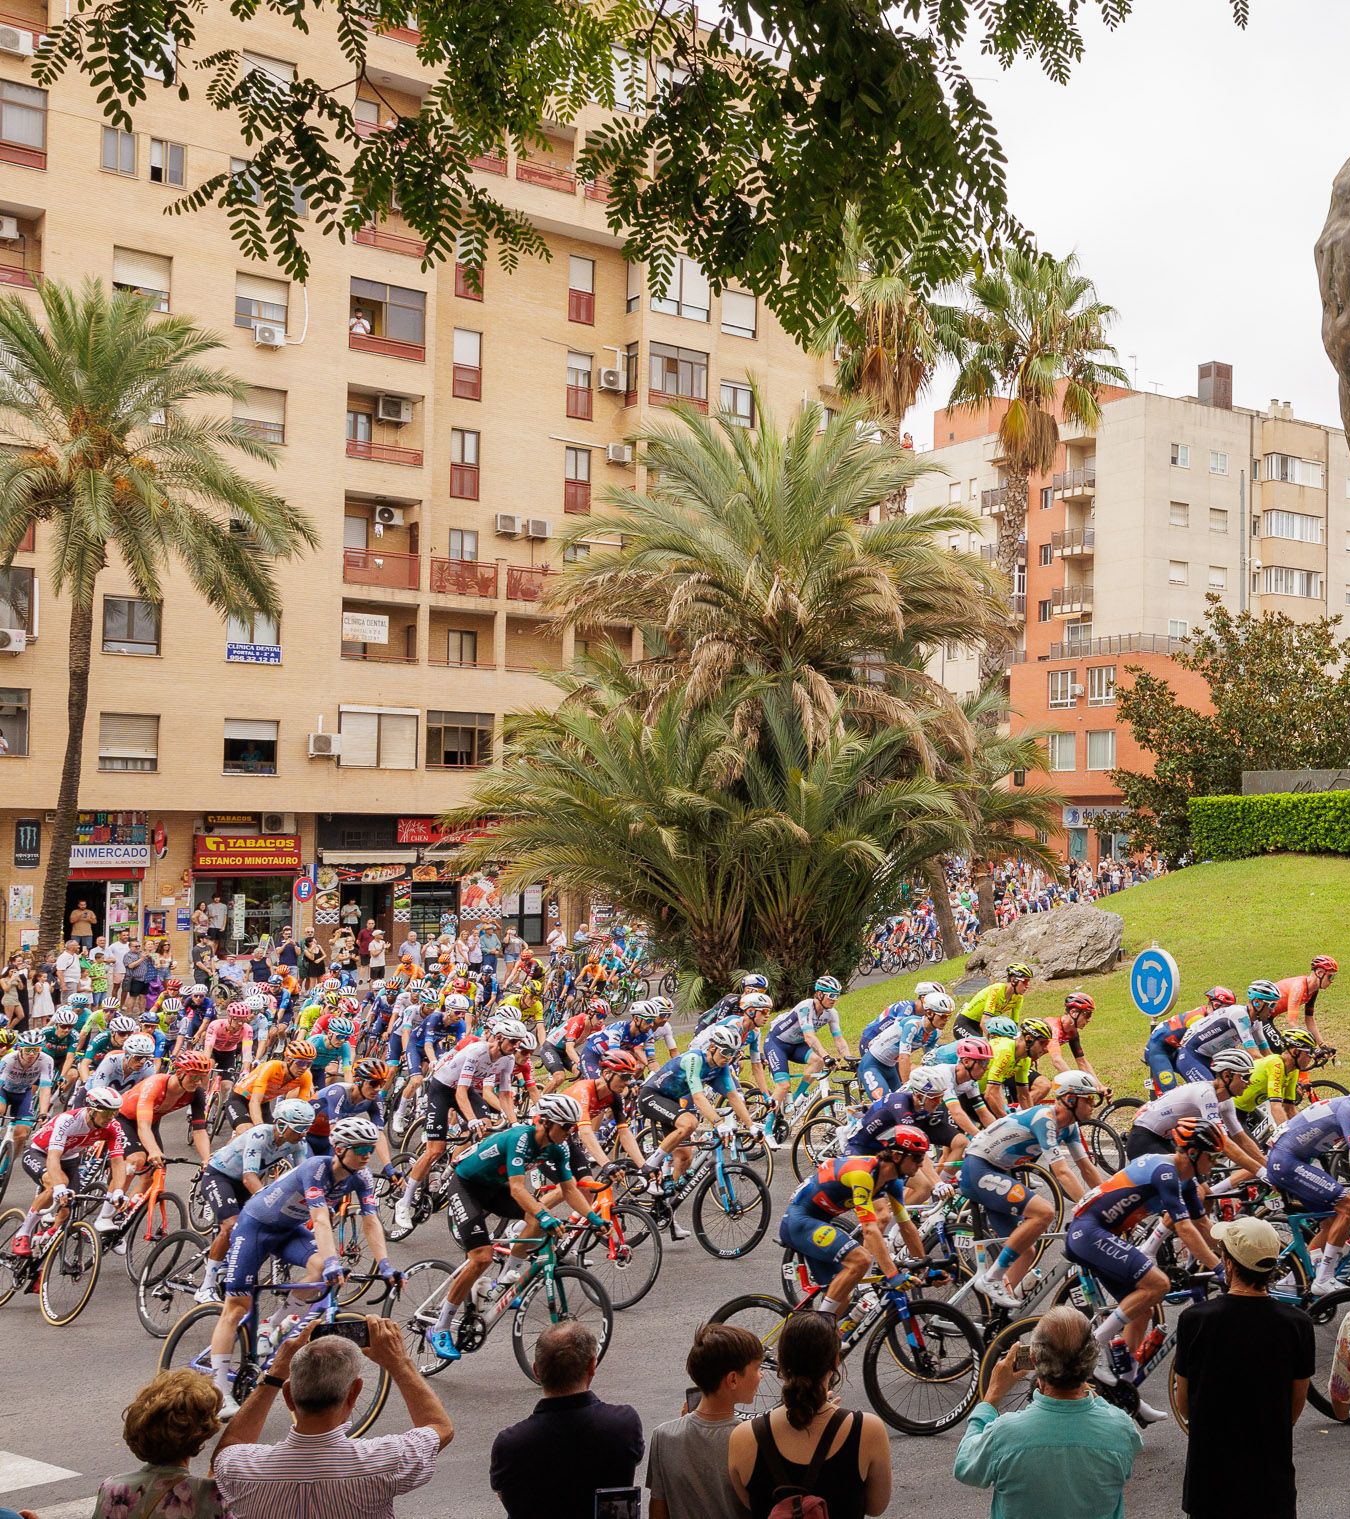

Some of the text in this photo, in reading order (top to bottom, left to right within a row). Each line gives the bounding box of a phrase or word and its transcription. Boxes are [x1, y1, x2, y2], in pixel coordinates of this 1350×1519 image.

[227, 643, 255, 651] CLÍNICA
[227, 839, 295, 847] TABACOS
[70, 847, 148, 858] INIMERCADO
[199, 856, 298, 865] ESTANCO MINOTAURO
[1199, 1026, 1222, 1041] BAHRAIN
[1272, 1062, 1282, 1094] ARKEA
[426, 1112, 436, 1130] UAE
[1296, 1126, 1321, 1145] Alpecin
[677, 1166, 710, 1201] VAN RYSEL
[1294, 1164, 1336, 1192] deceuninck
[450, 1193, 469, 1223] KERN
[1101, 1193, 1141, 1224] Jayco
[1271, 1201, 1281, 1210] 75
[957, 1236, 971, 1247] 175
[832, 1240, 858, 1262] TREK
[1094, 1238, 1129, 1264] ALULA
[1073, 1288, 1083, 1306] 144
[851, 1306, 882, 1341] TREK
